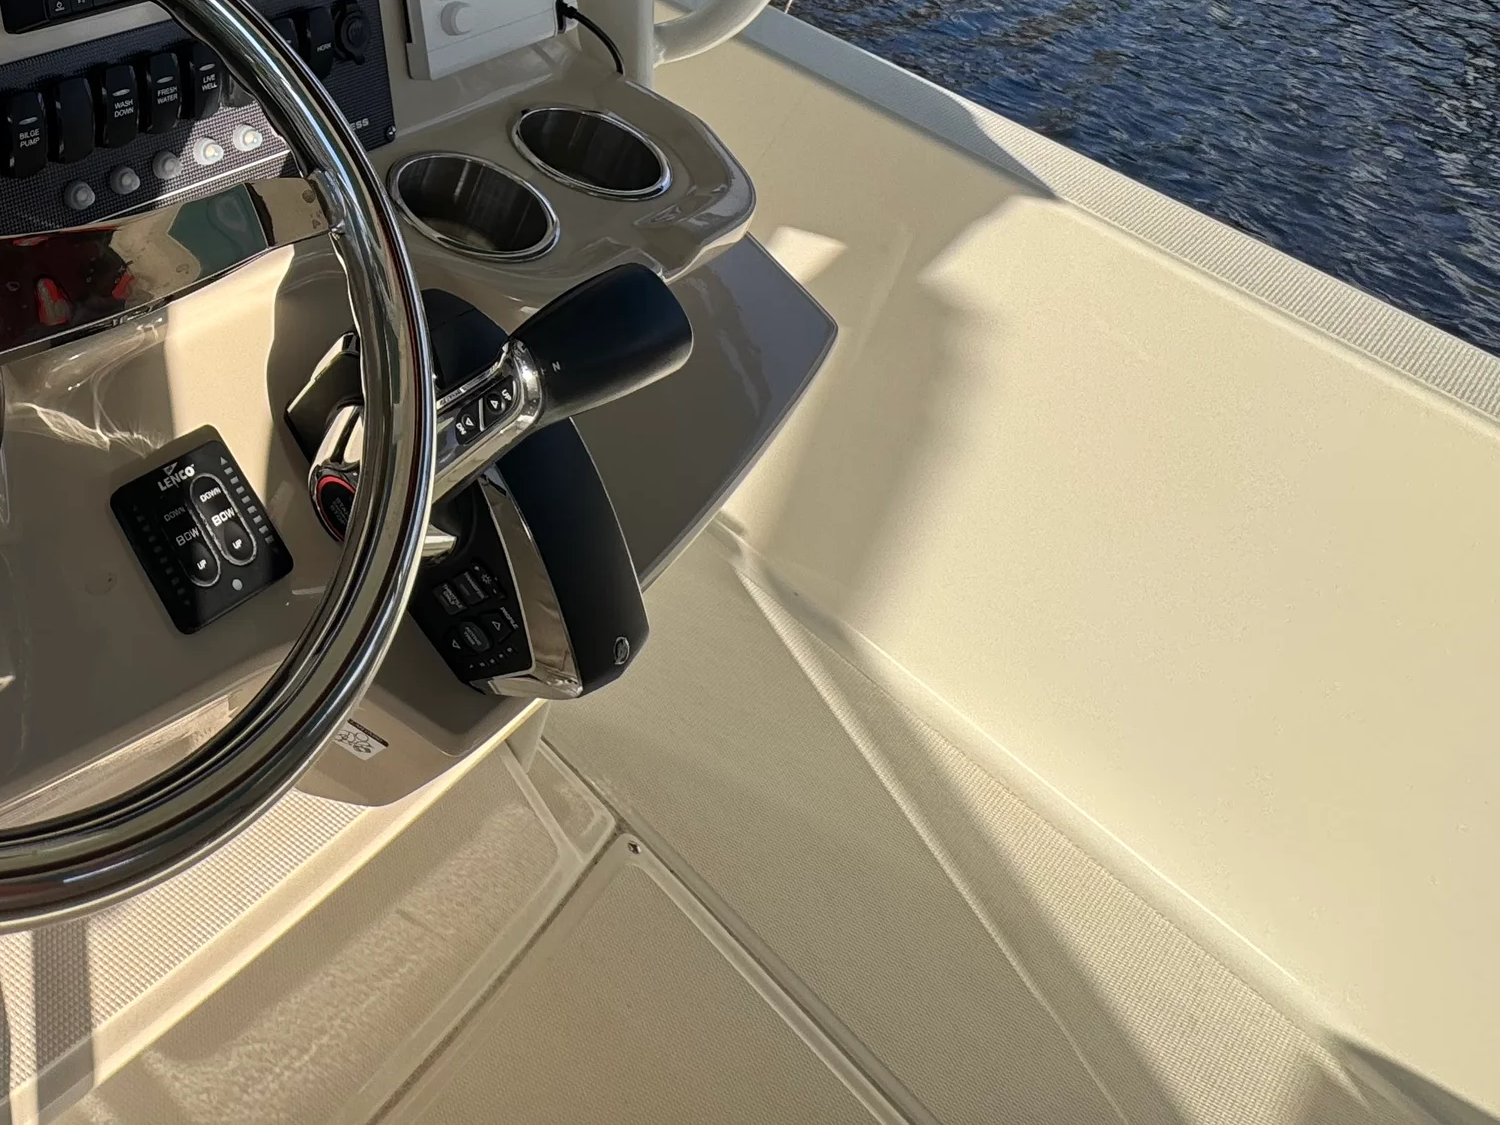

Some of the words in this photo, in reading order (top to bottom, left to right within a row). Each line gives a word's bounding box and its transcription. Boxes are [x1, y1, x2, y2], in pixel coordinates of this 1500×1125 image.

[317, 42, 332, 52] HORN
[203, 74, 216, 83] LIVE
[157, 86, 178, 97] FRESH
[201, 82, 218, 92] WELL
[114, 99, 134, 110] WASH
[157, 93, 178, 105] WATER
[114, 107, 134, 118] DOWN
[19, 128, 40, 140] BILGE
[20, 137, 40, 148] PUMP
[552, 361, 561, 372] N
[501, 389, 512, 401] UP
[455, 422, 467, 435] DN
[157, 465, 196, 491] LENCO
[200, 487, 221, 503] DOWN
[164, 506, 185, 522] DOWN
[211, 507, 235, 527] BOW
[175, 527, 199, 546] BOW
[232, 539, 242, 550] UP
[197, 559, 207, 570] UP
[500, 606, 519, 629] PROFILE
